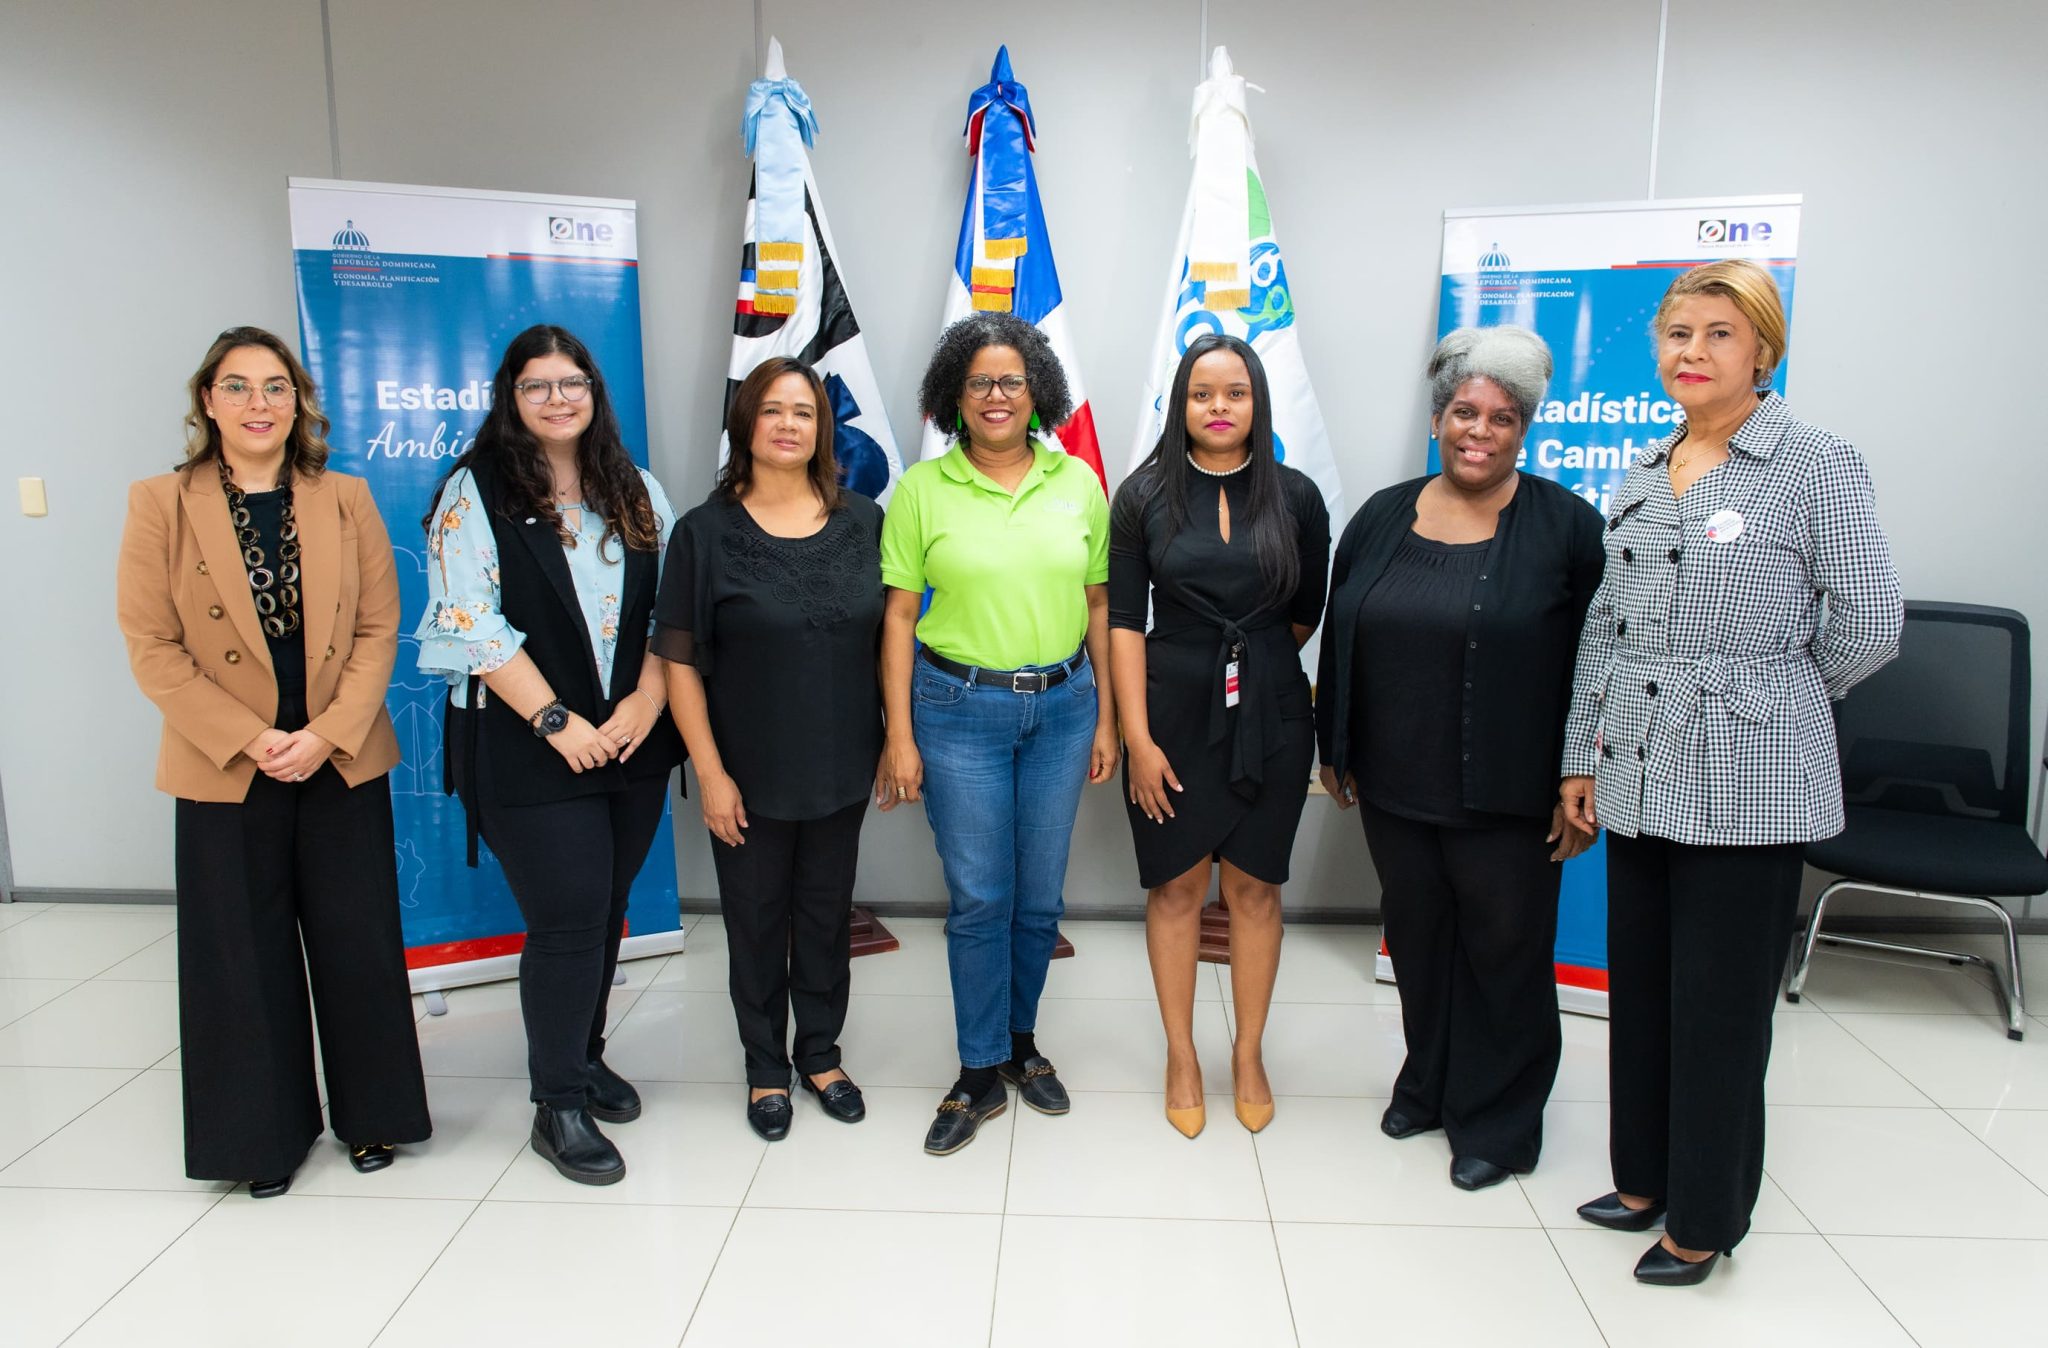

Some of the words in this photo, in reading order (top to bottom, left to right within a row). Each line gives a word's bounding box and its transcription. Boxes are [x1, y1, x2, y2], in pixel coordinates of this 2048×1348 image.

[333, 258, 380, 267] REPÚBLICA
[382, 261, 436, 269] DOMINICANA
[333, 273, 379, 281] ECONOMÍA,
[380, 275, 439, 283] PLANIFICACIÓN
[1519, 277, 1572, 285] DOMINICANA
[377, 380, 495, 410] Estadí
